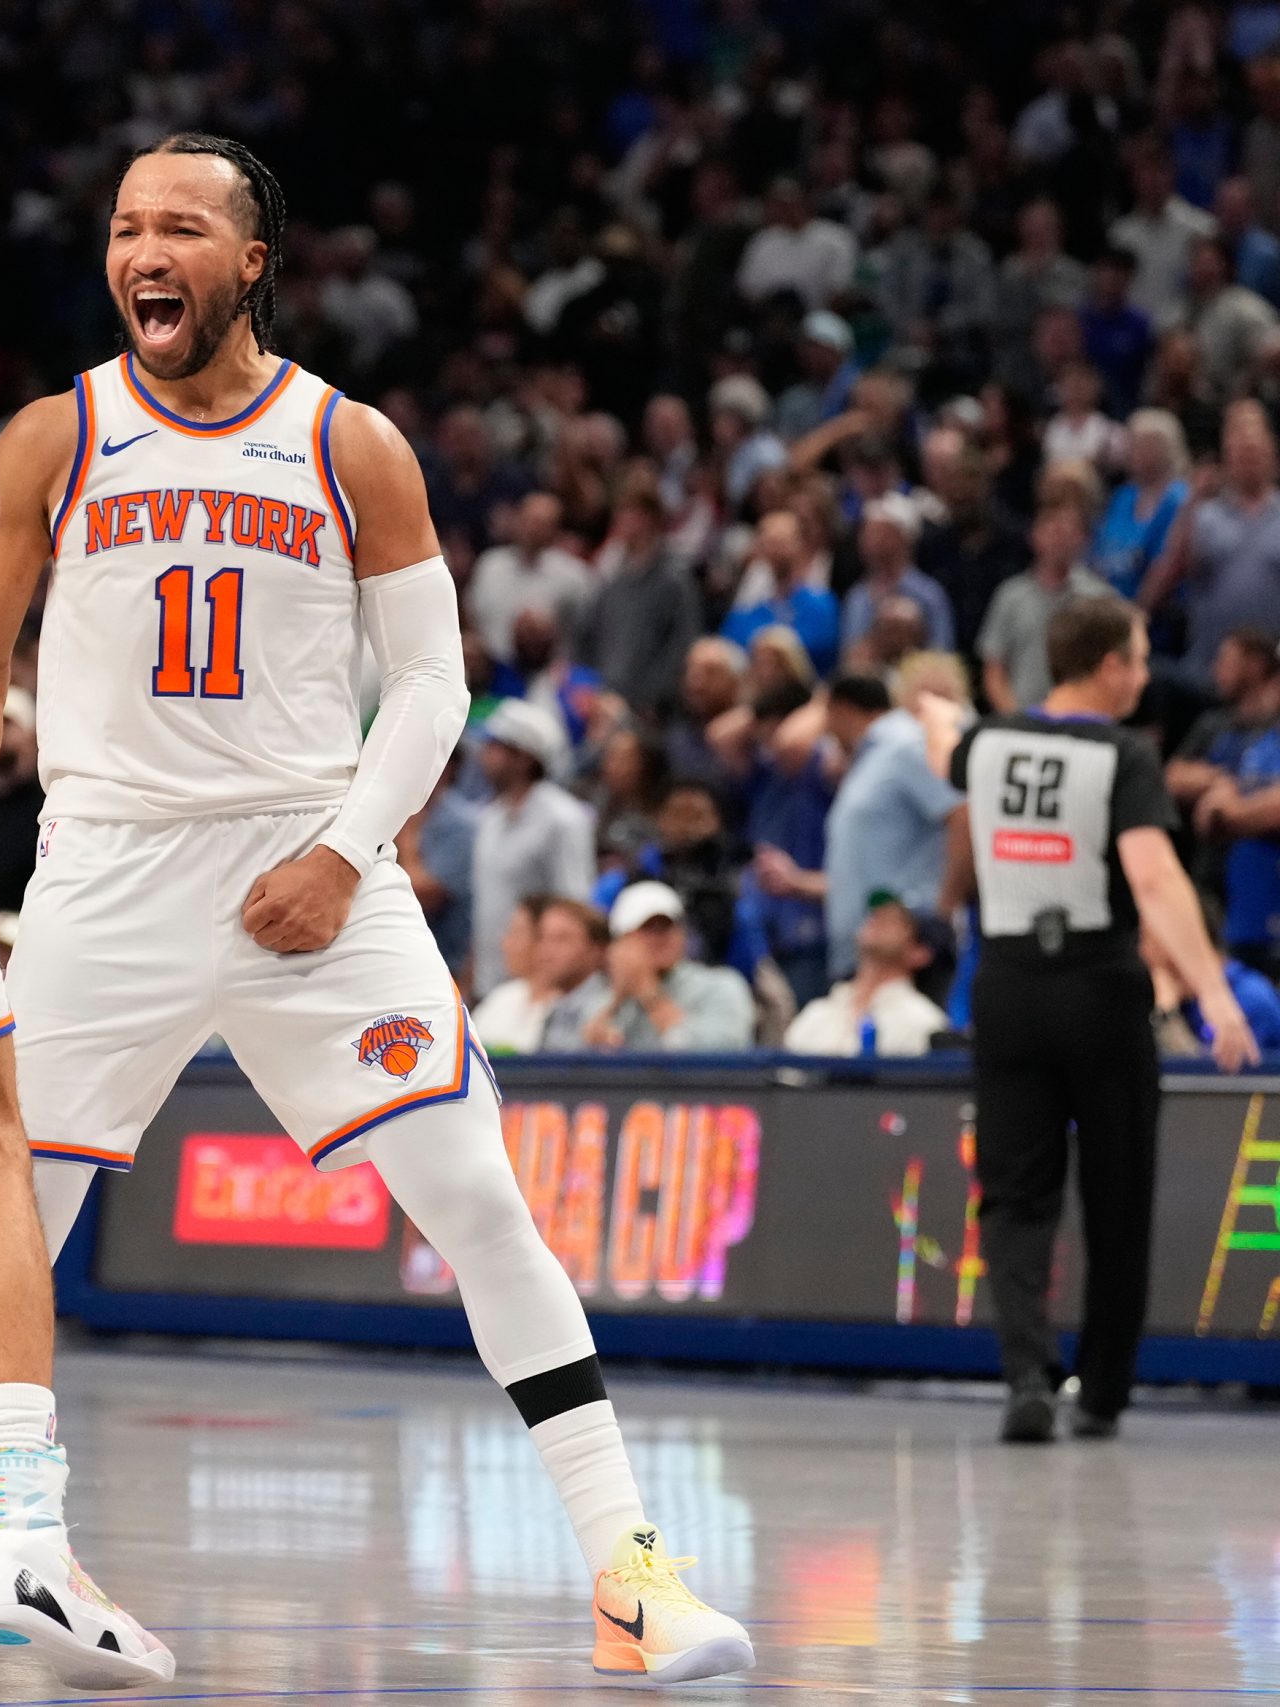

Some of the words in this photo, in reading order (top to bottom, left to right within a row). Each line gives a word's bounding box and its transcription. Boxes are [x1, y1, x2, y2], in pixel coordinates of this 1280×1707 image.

[242, 448, 267, 459] abu
[269, 450, 306, 464] dhabi
[244, 441, 278, 450] experience
[85, 488, 195, 558] NEW
[199, 488, 326, 571] YORK
[152, 565, 245, 700] 11
[1001, 754, 1064, 820] 52
[357, 1016, 434, 1063] KNICKS
[608, 1100, 762, 1301] CUP
